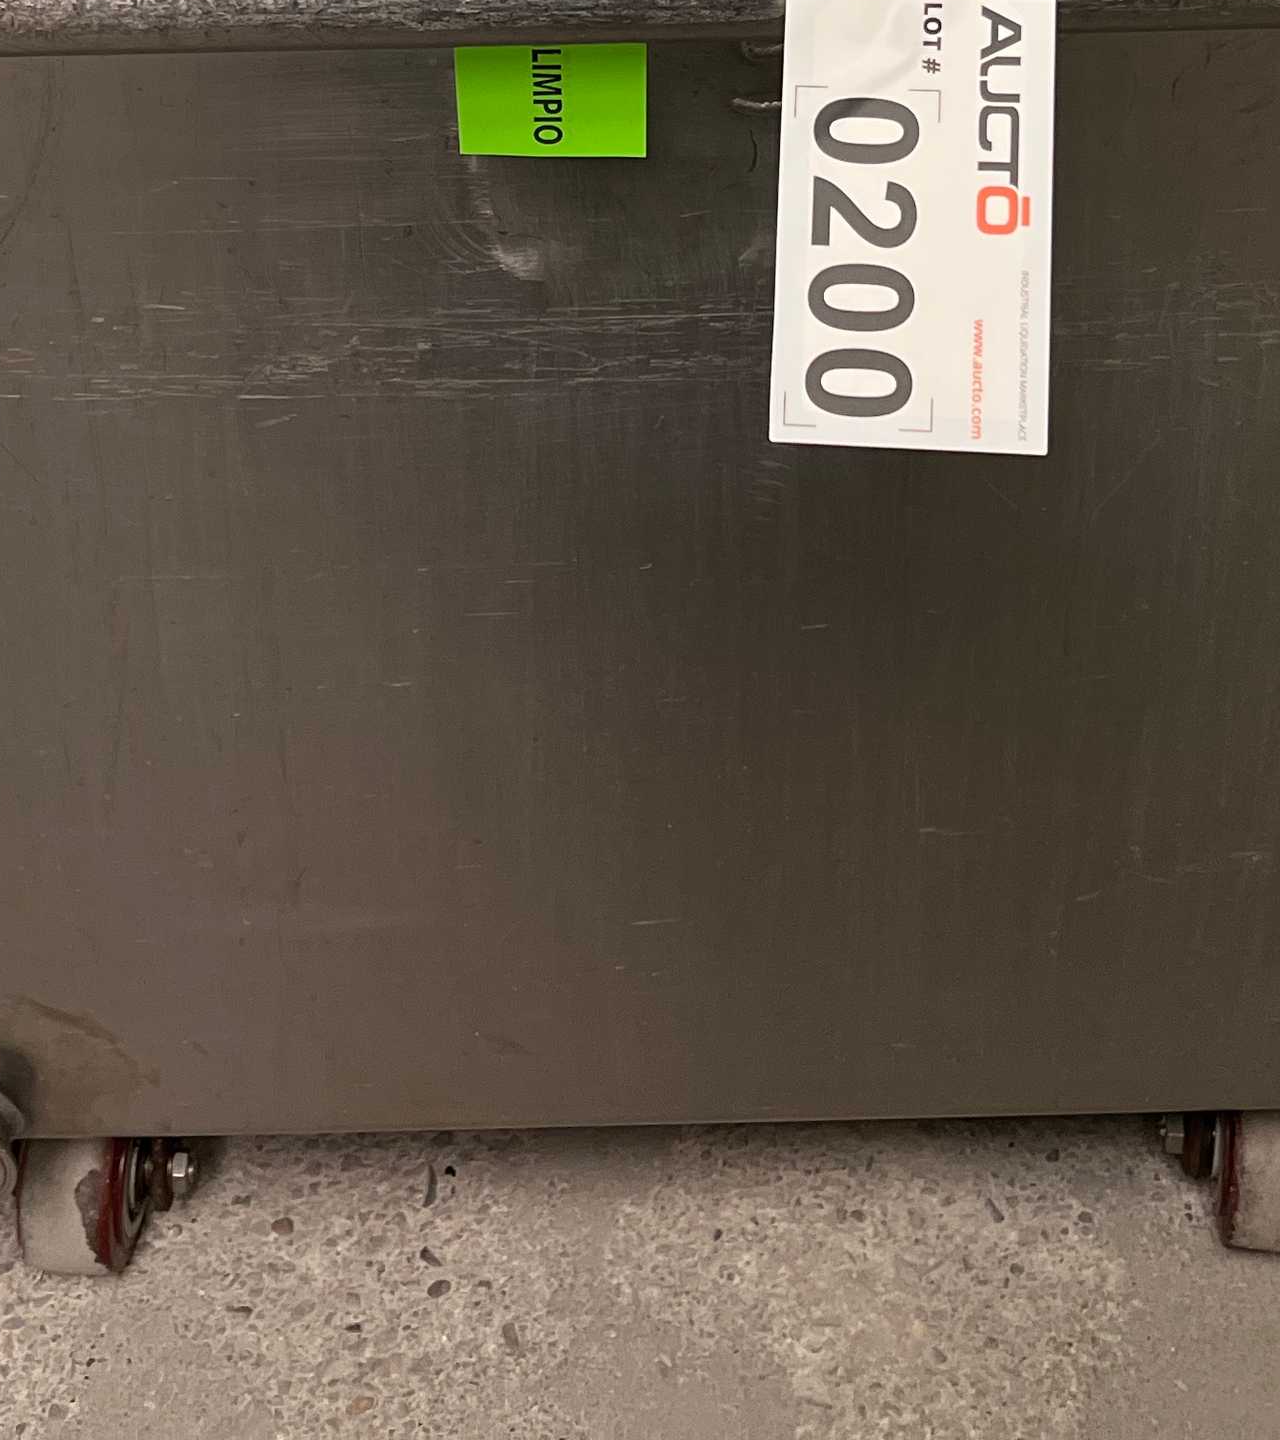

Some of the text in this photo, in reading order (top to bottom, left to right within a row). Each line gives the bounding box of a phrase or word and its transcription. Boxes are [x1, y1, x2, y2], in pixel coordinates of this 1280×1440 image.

[922, 2, 943, 75] LOT #
[531, 49, 564, 145] LIMPIO
[805, 97, 920, 418] 0200
[970, 319, 984, 440] www.aucto.com
[1019, 322, 1030, 378] LIQUIDATION
[1017, 380, 1029, 441] MARKETPLACE
